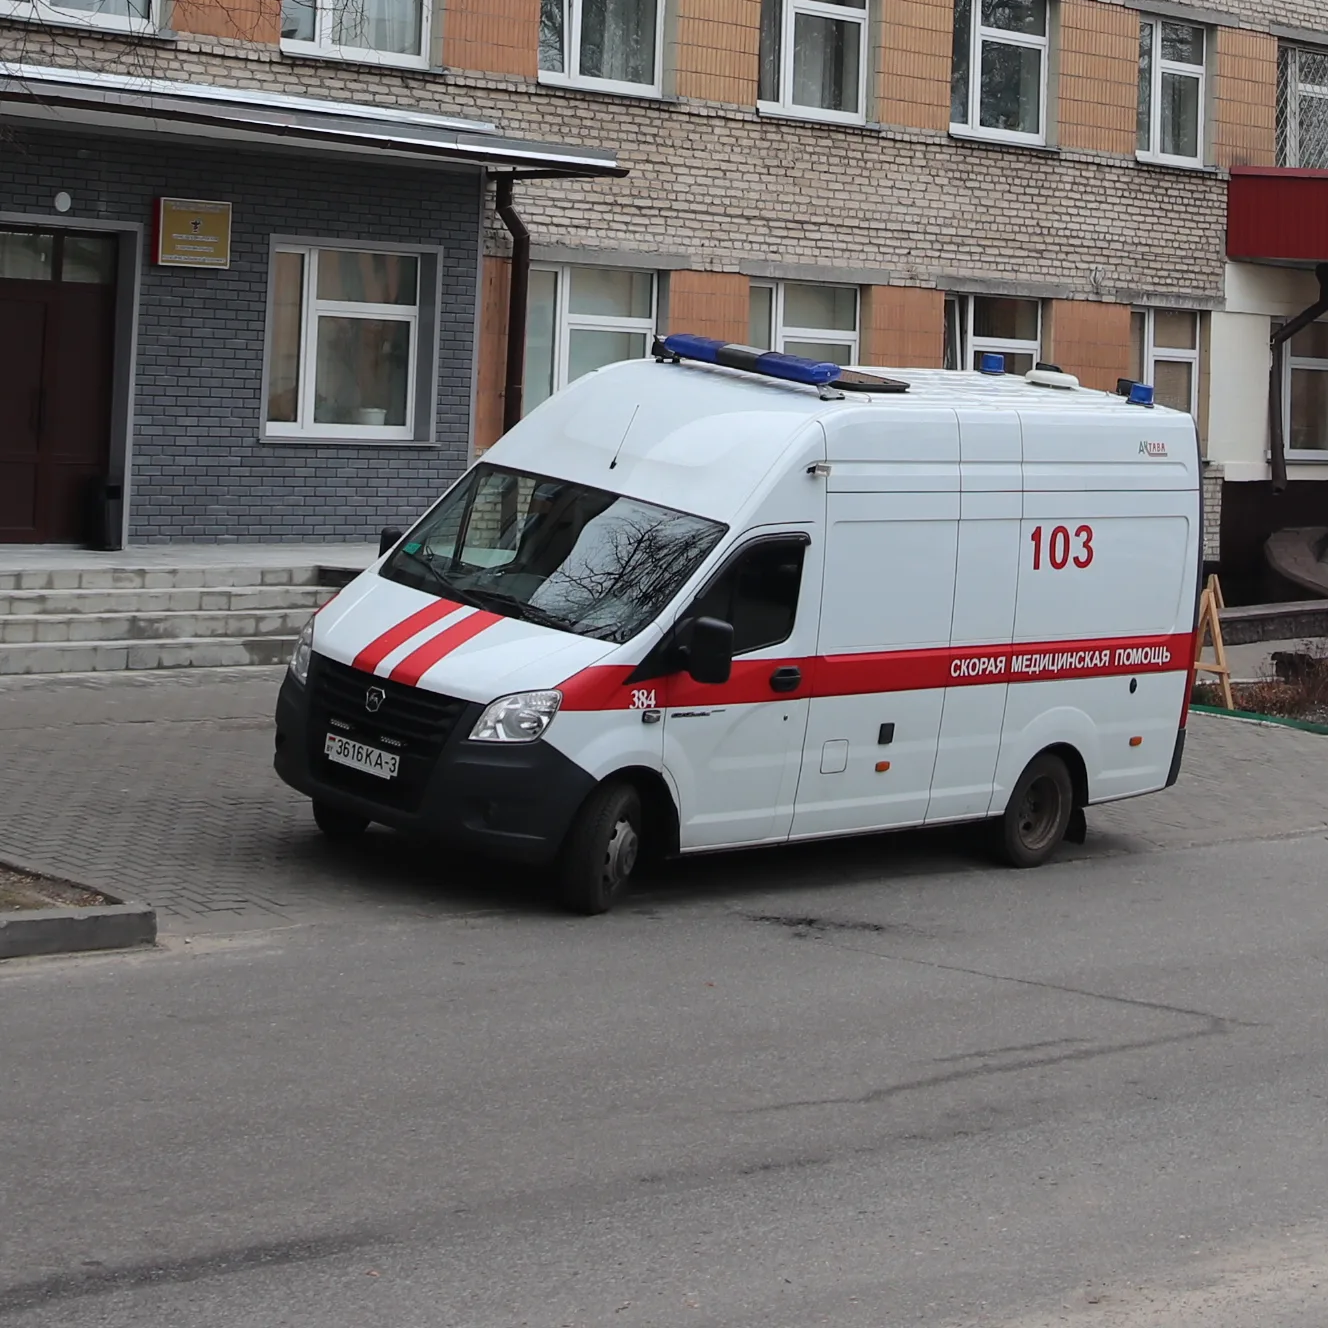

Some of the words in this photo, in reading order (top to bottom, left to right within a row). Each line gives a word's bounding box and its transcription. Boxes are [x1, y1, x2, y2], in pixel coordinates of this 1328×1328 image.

[1031, 525, 1094, 570] 103
[950, 657, 1006, 677] СКОРАЯ
[1010, 650, 1109, 674] МЕДИЦИНСКАЯ
[1114, 646, 1171, 666] ПОМОЩЬ
[629, 689, 656, 709] 384
